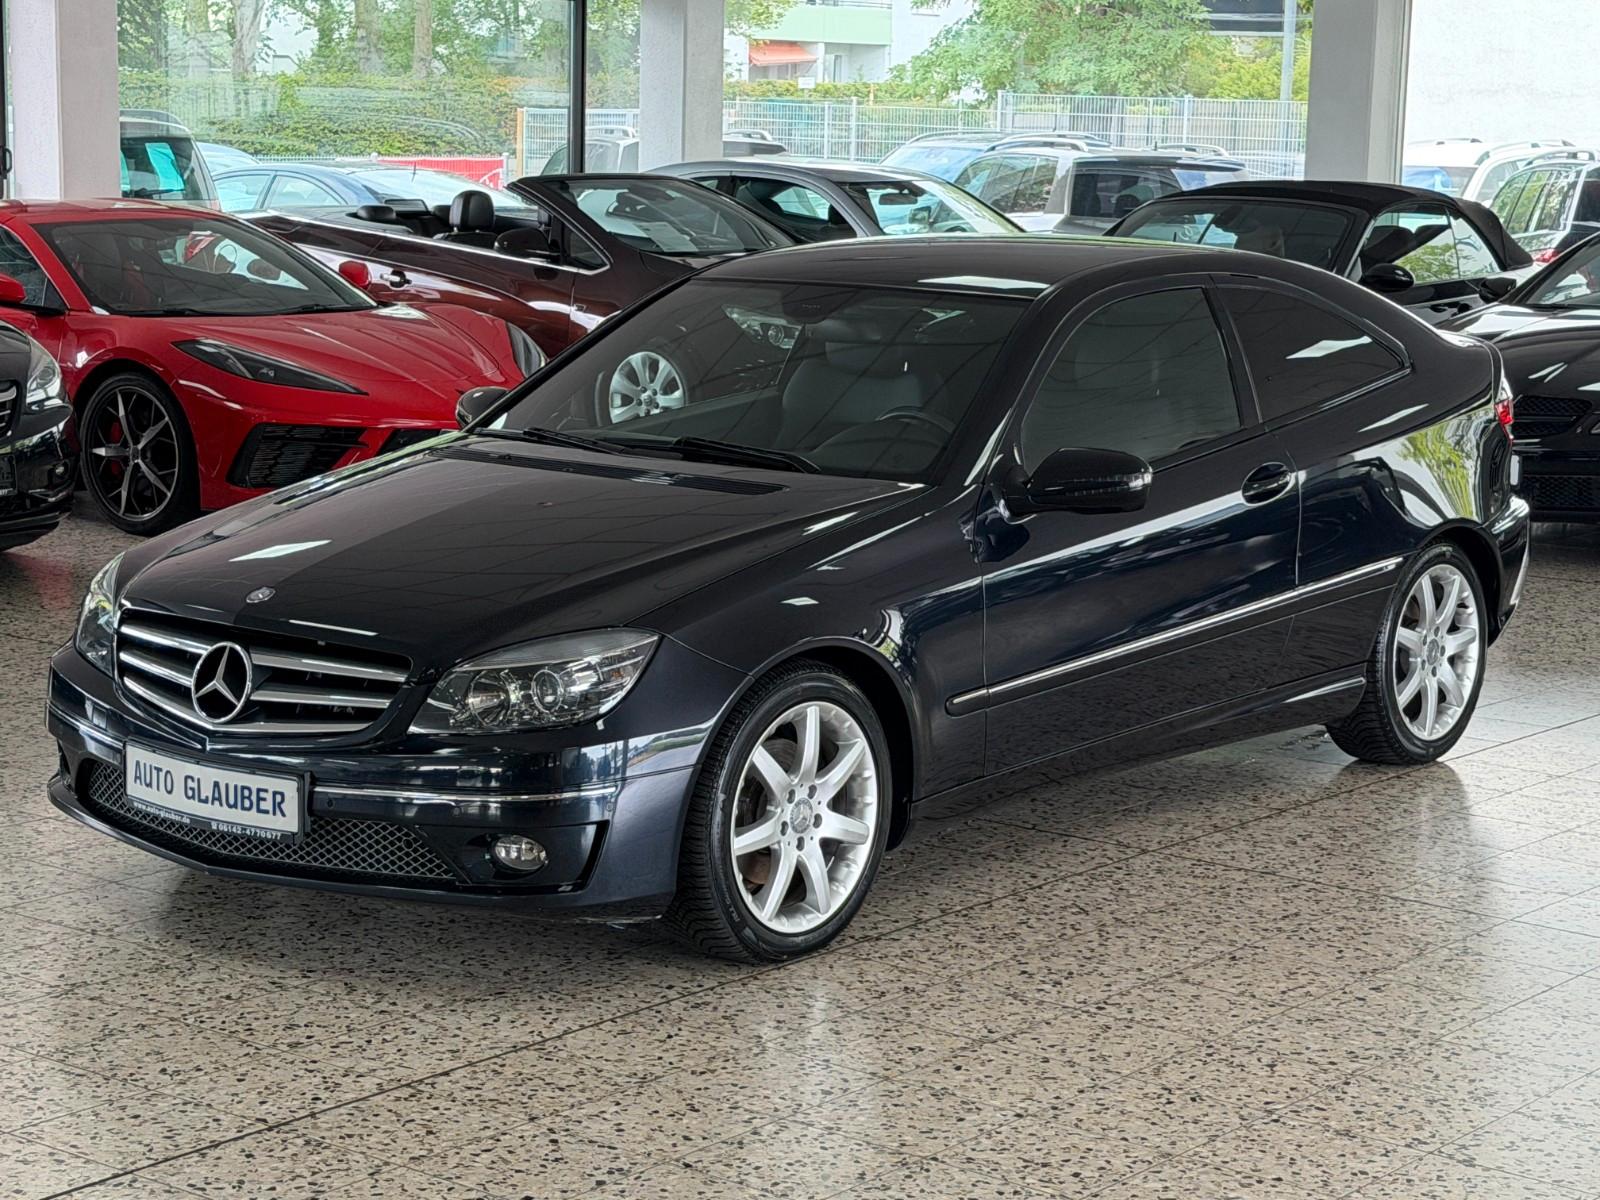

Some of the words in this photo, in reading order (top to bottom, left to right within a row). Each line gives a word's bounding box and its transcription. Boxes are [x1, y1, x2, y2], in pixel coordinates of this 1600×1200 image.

[134, 760, 174, 795] AUTO
[184, 775, 286, 817] GLAUBER
[133, 801, 190, 823] www.auto-glauber.de
